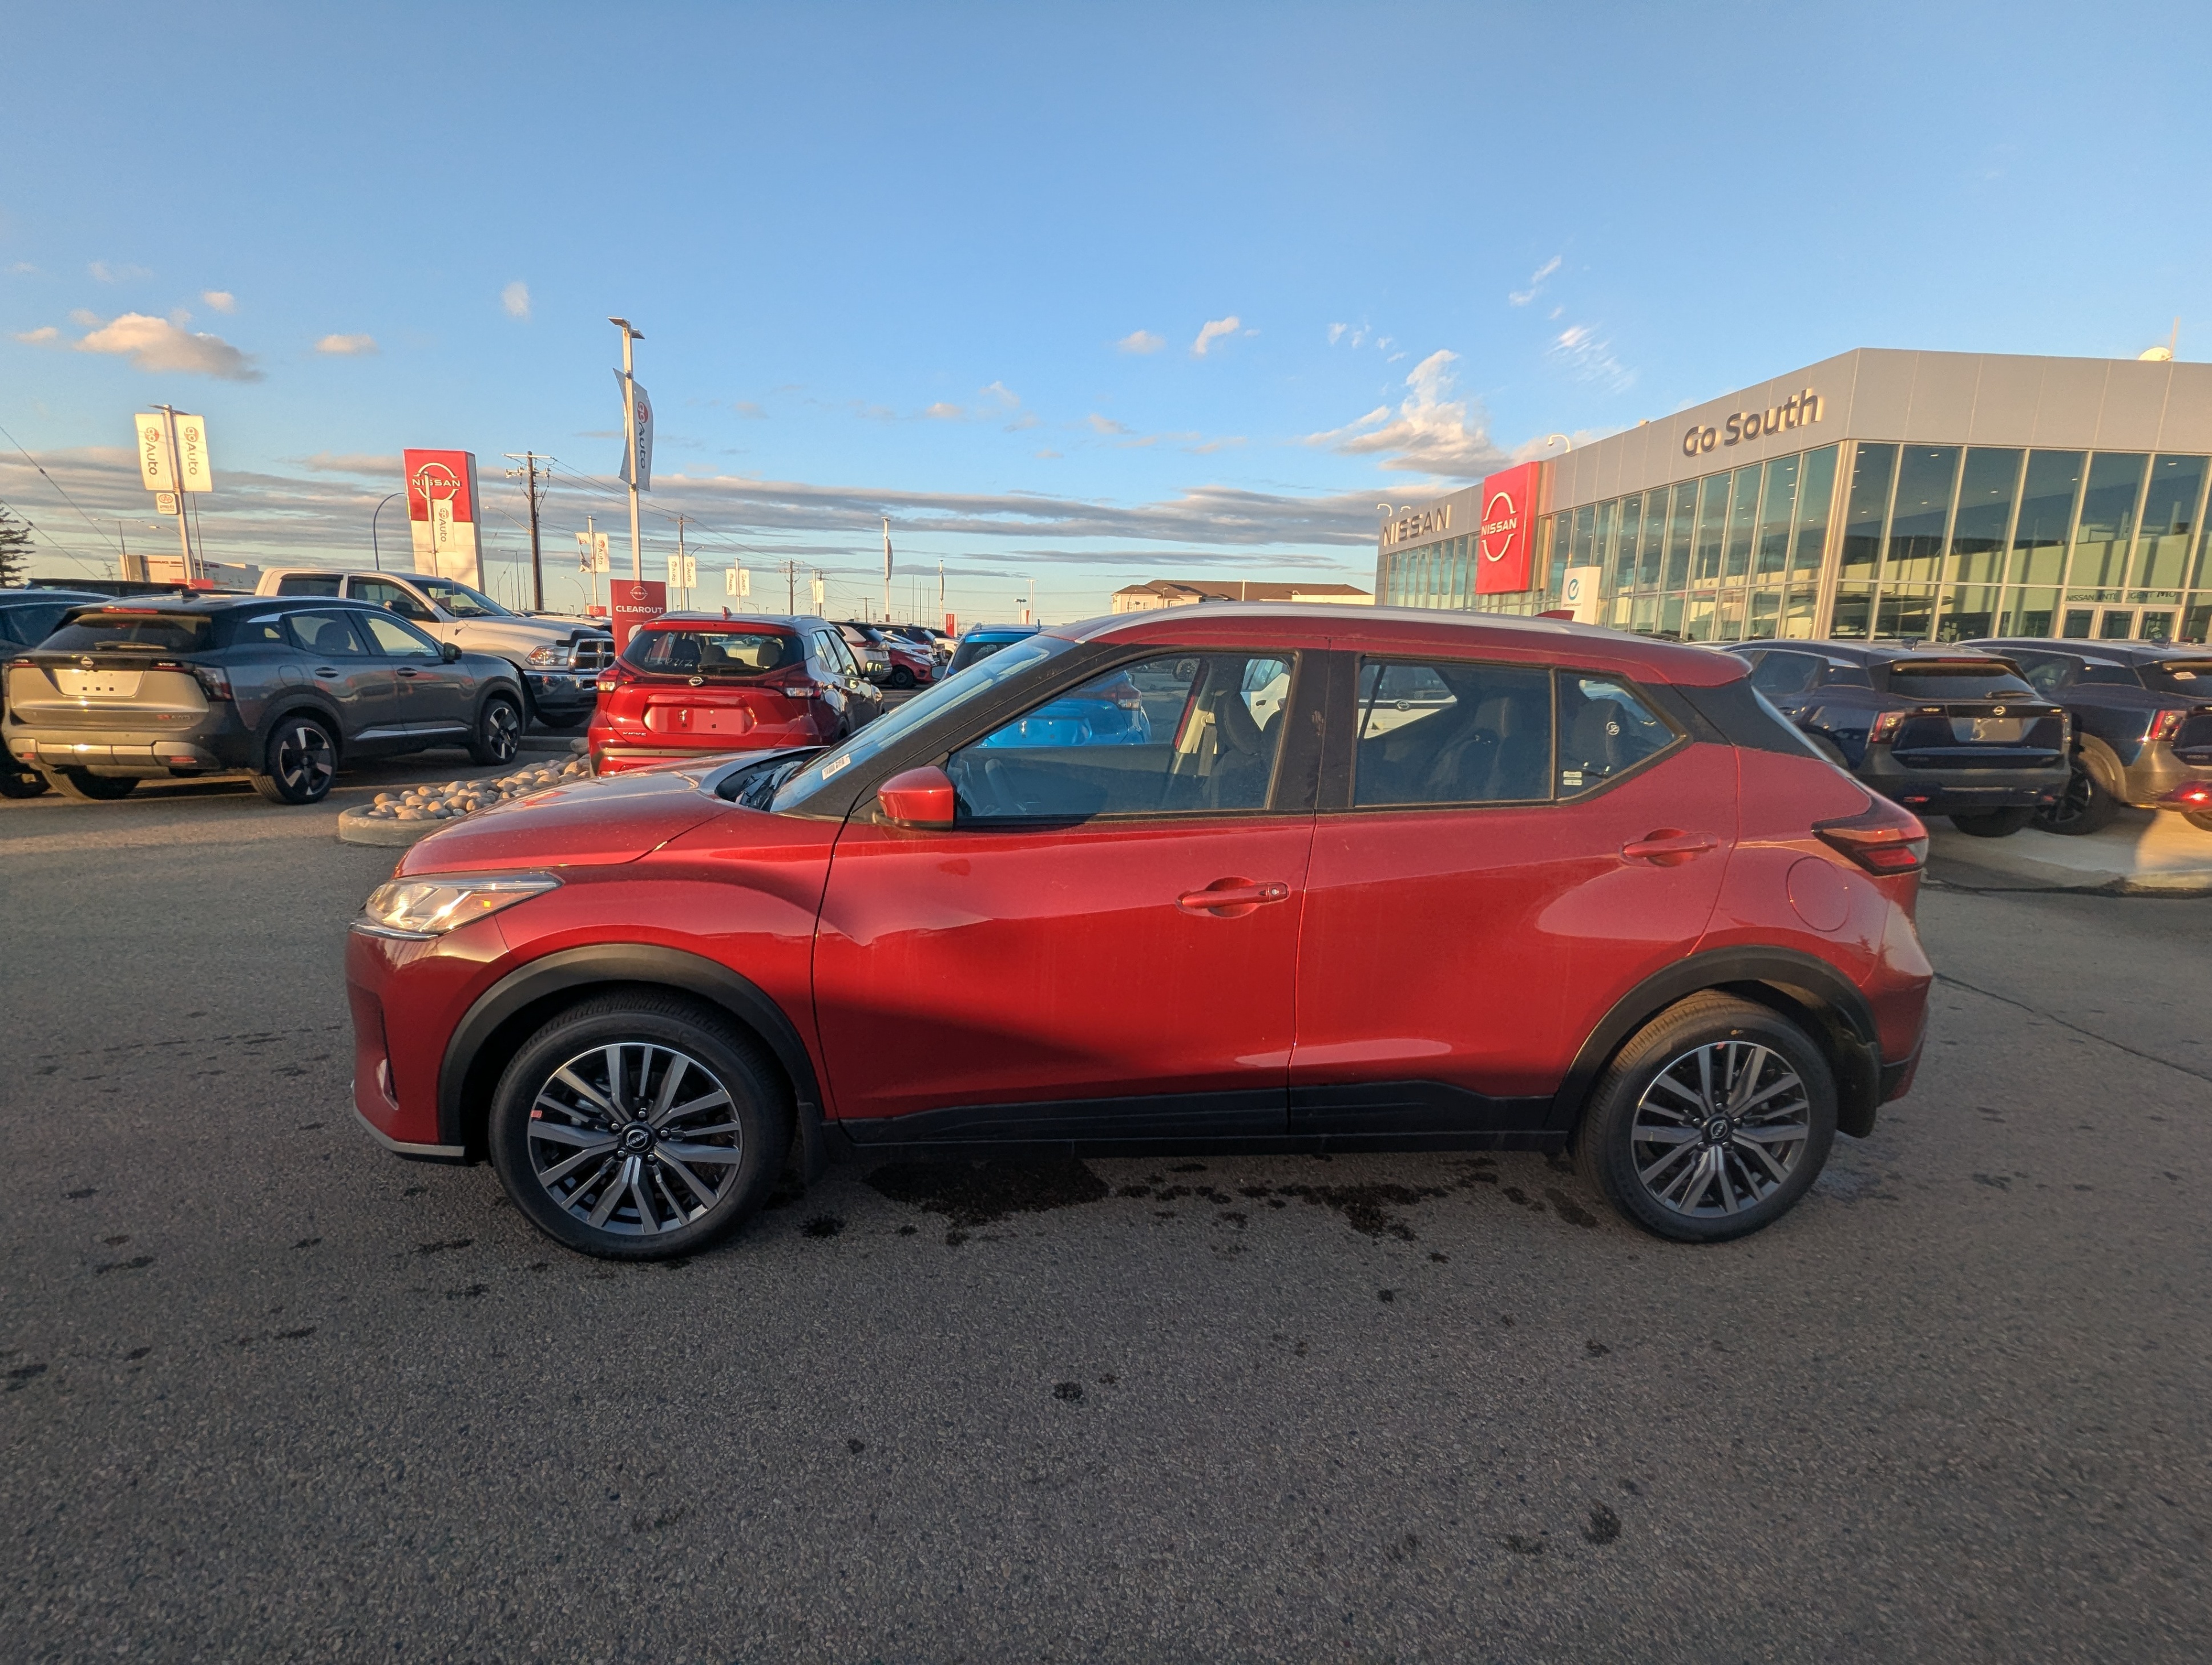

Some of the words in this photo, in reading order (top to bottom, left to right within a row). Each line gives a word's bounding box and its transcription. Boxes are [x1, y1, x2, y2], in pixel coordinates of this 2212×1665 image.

[1682, 426, 1722, 457] Go
[1723, 388, 1823, 447] South
[1382, 504, 1452, 547] NISSAN
[1481, 518, 1517, 536] NISSAN
[615, 605, 663, 614] CLEAROUT
